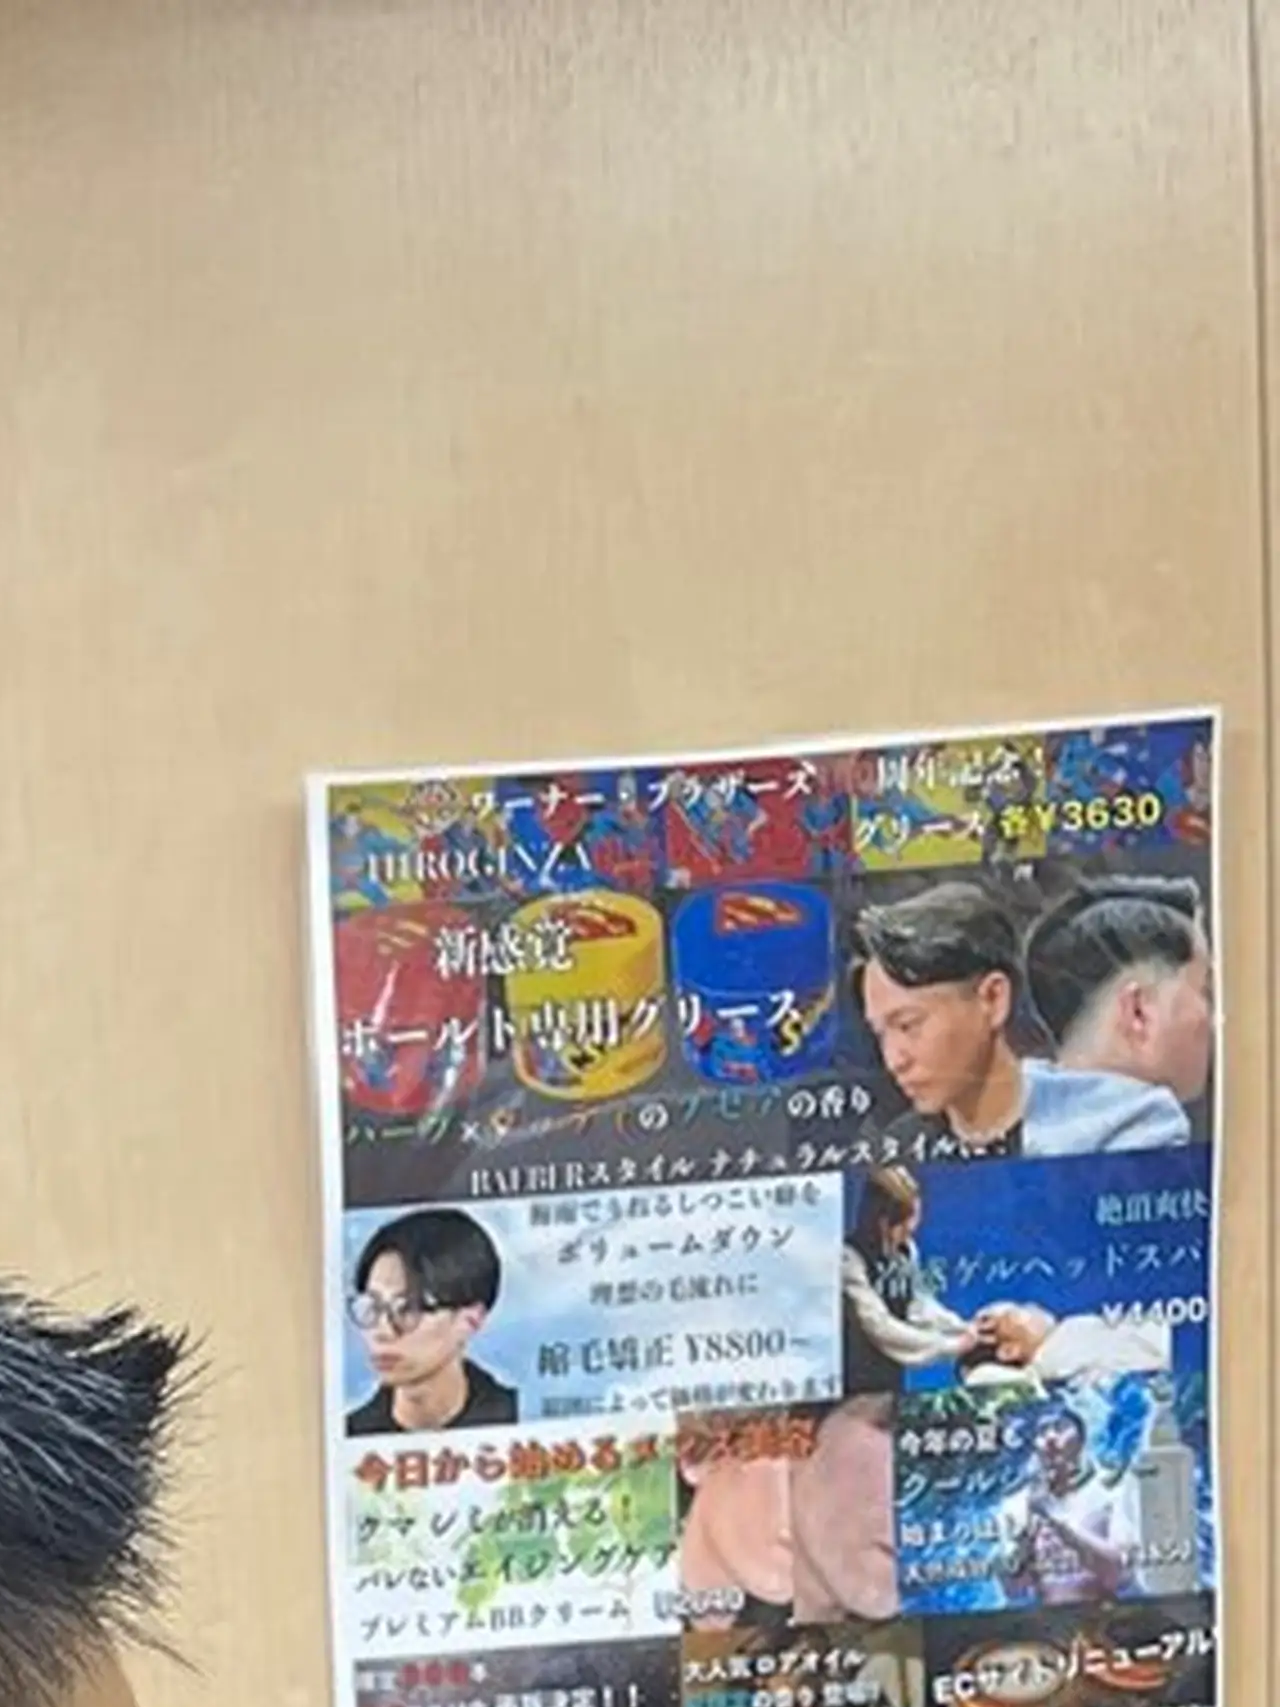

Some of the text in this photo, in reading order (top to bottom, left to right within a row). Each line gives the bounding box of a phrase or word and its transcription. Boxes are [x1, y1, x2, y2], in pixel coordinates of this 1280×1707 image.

[433, 916, 574, 978] 新感覚
[557, 1224, 794, 1265] ボリュームダウン
[537, 1333, 675, 1378] 縮毛矯正
